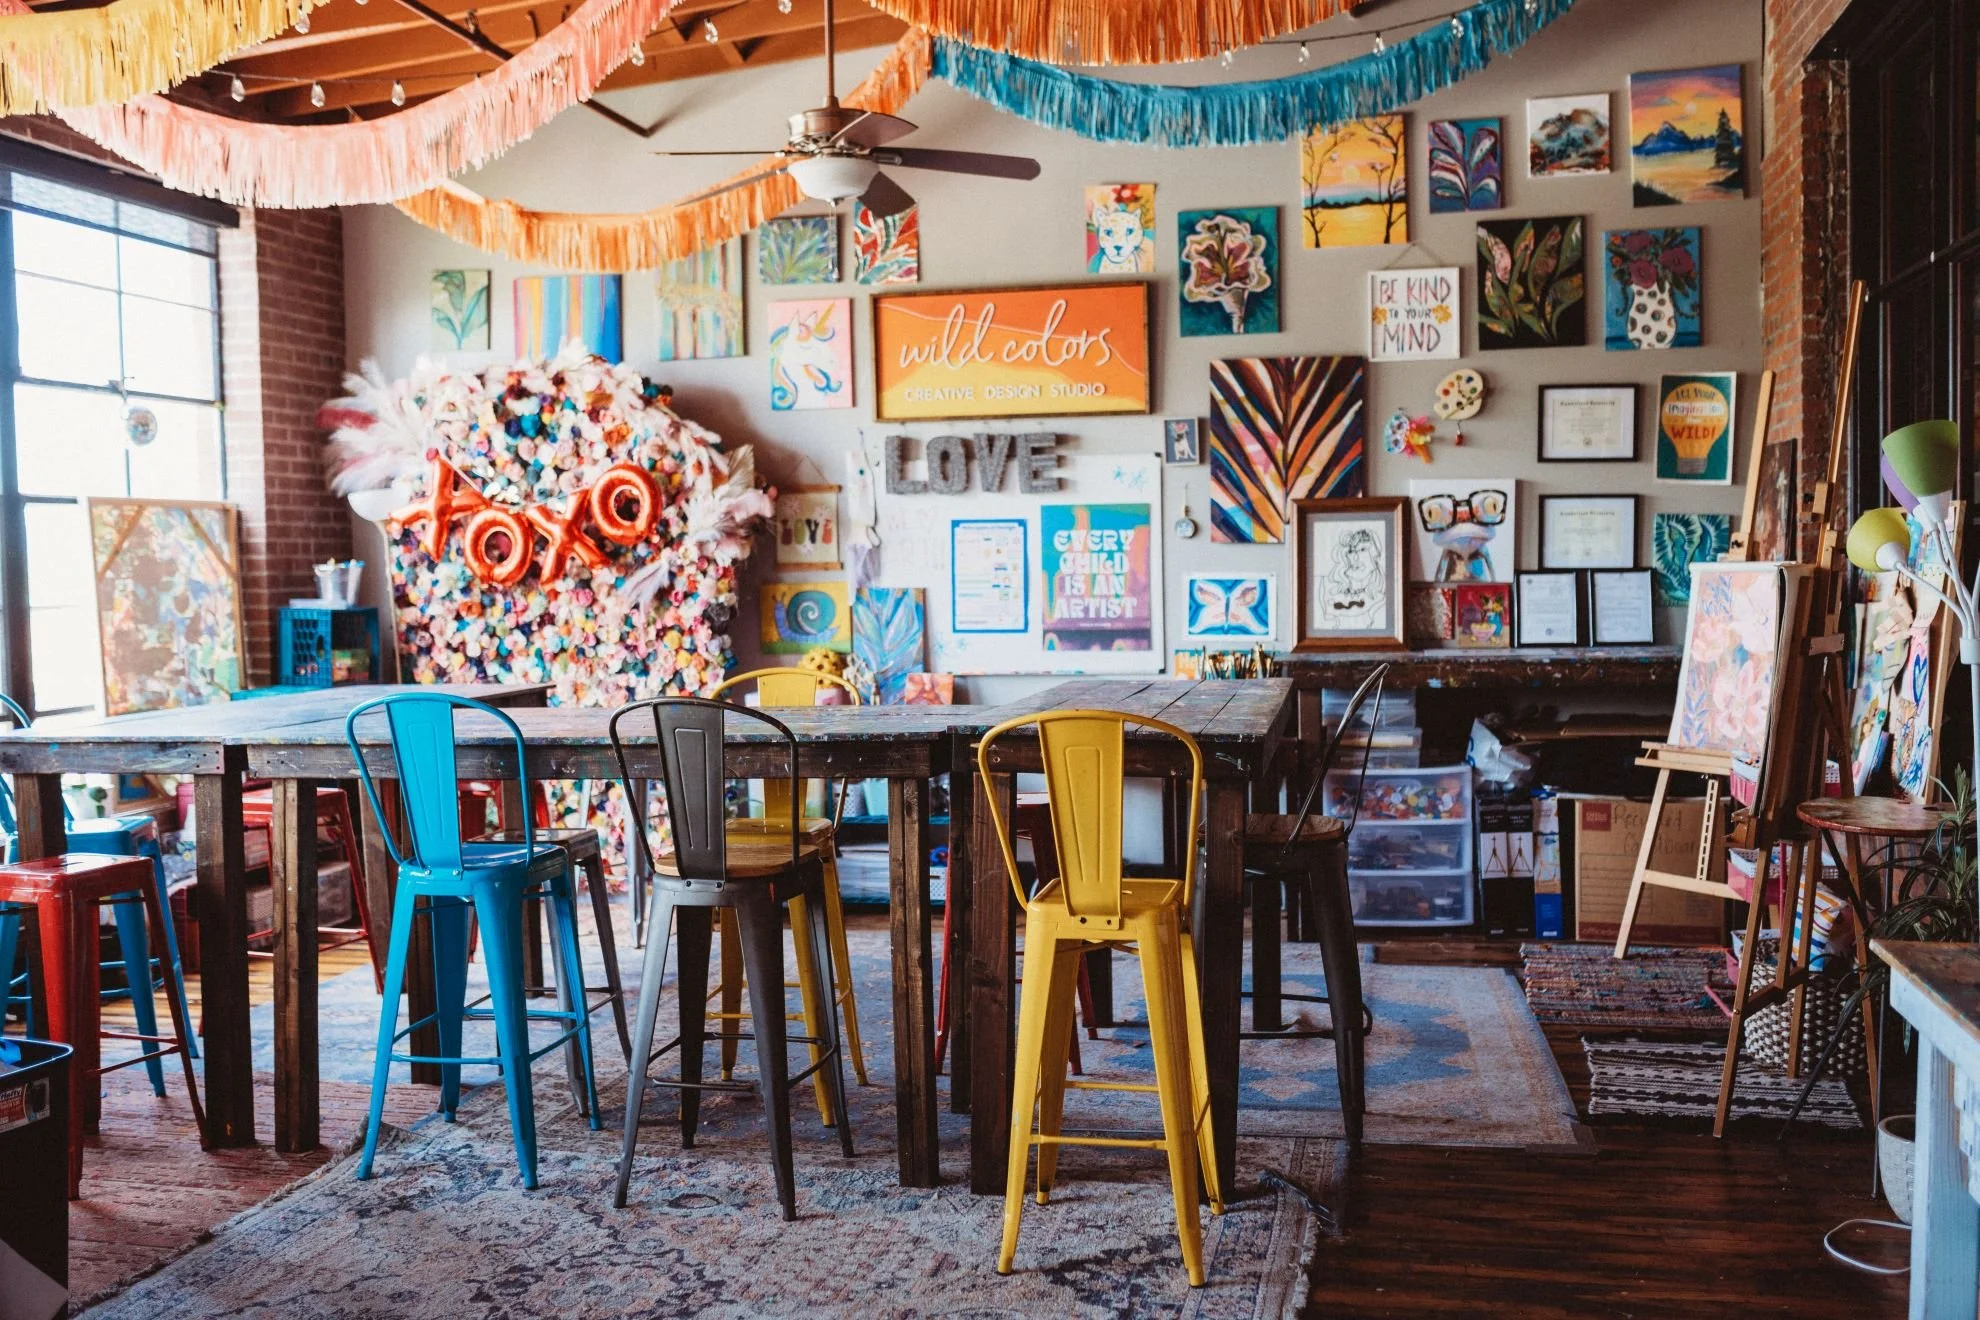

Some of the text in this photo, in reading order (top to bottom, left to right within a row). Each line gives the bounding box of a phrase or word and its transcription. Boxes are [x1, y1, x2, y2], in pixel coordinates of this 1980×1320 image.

[1380, 275, 1451, 306] BE KIND
[1388, 308, 1432, 320] TO YOUR
[900, 299, 1112, 371] wild colors
[1382, 321, 1441, 354] MIND
[904, 382, 1106, 401] CREATIVE DESIGN STUDIO
[885, 432, 1061, 495] LOVE
[1053, 529, 1135, 552] EVERY
[1059, 551, 1131, 574] CHILD
[1064, 574, 1126, 597] IS AN
[1054, 597, 1138, 619] ARTIST
